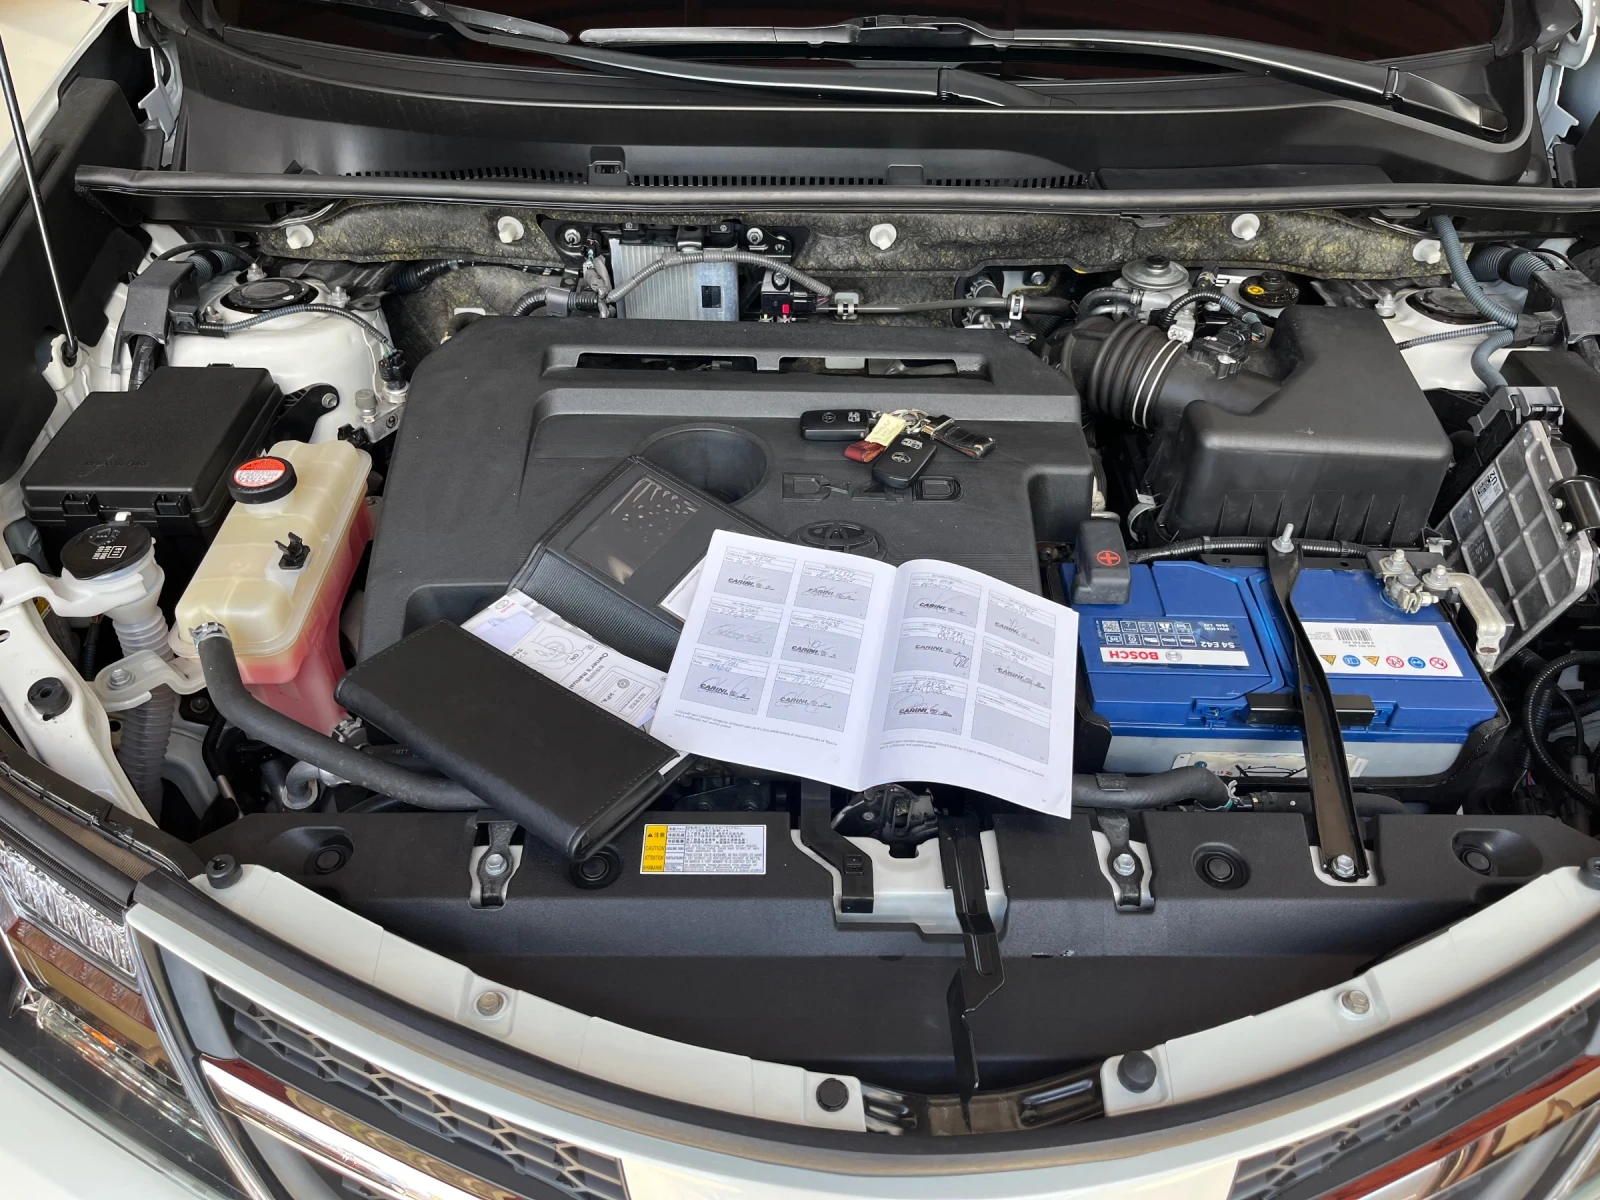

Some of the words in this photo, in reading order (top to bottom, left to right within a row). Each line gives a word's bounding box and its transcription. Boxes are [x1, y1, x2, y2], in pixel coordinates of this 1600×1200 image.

[1221, 641, 1235, 649] S4
[569, 652, 579, 662] ON
[1108, 650, 1159, 660] BOSCH
[585, 651, 609, 674] Owner's
[568, 671, 588, 690] manual
